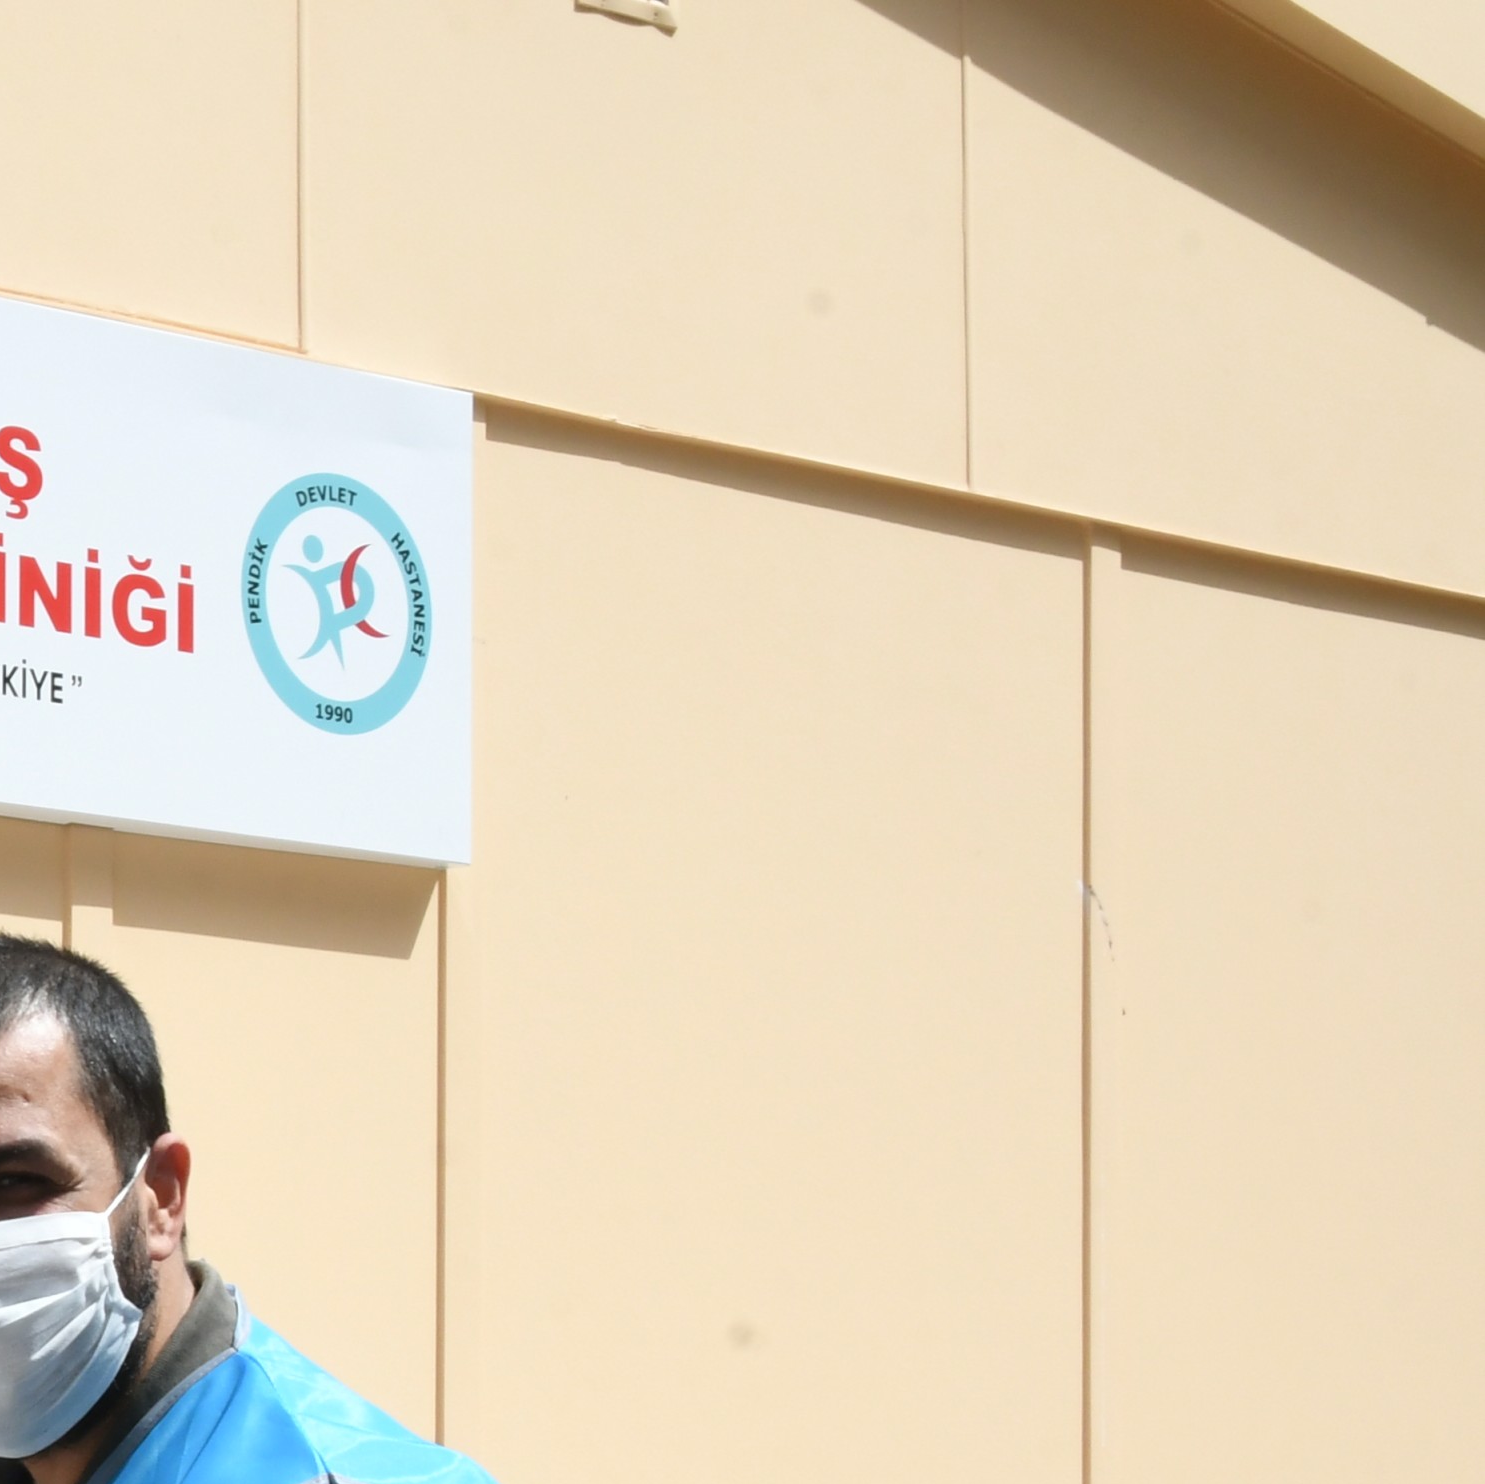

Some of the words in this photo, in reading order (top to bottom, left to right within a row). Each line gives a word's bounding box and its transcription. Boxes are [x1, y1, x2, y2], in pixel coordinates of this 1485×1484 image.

[248, 538, 269, 625] PENDİK
[295, 485, 358, 508] DEVLET
[390, 532, 426, 657] HASTANESİ
[315, 703, 354, 725] 1990
